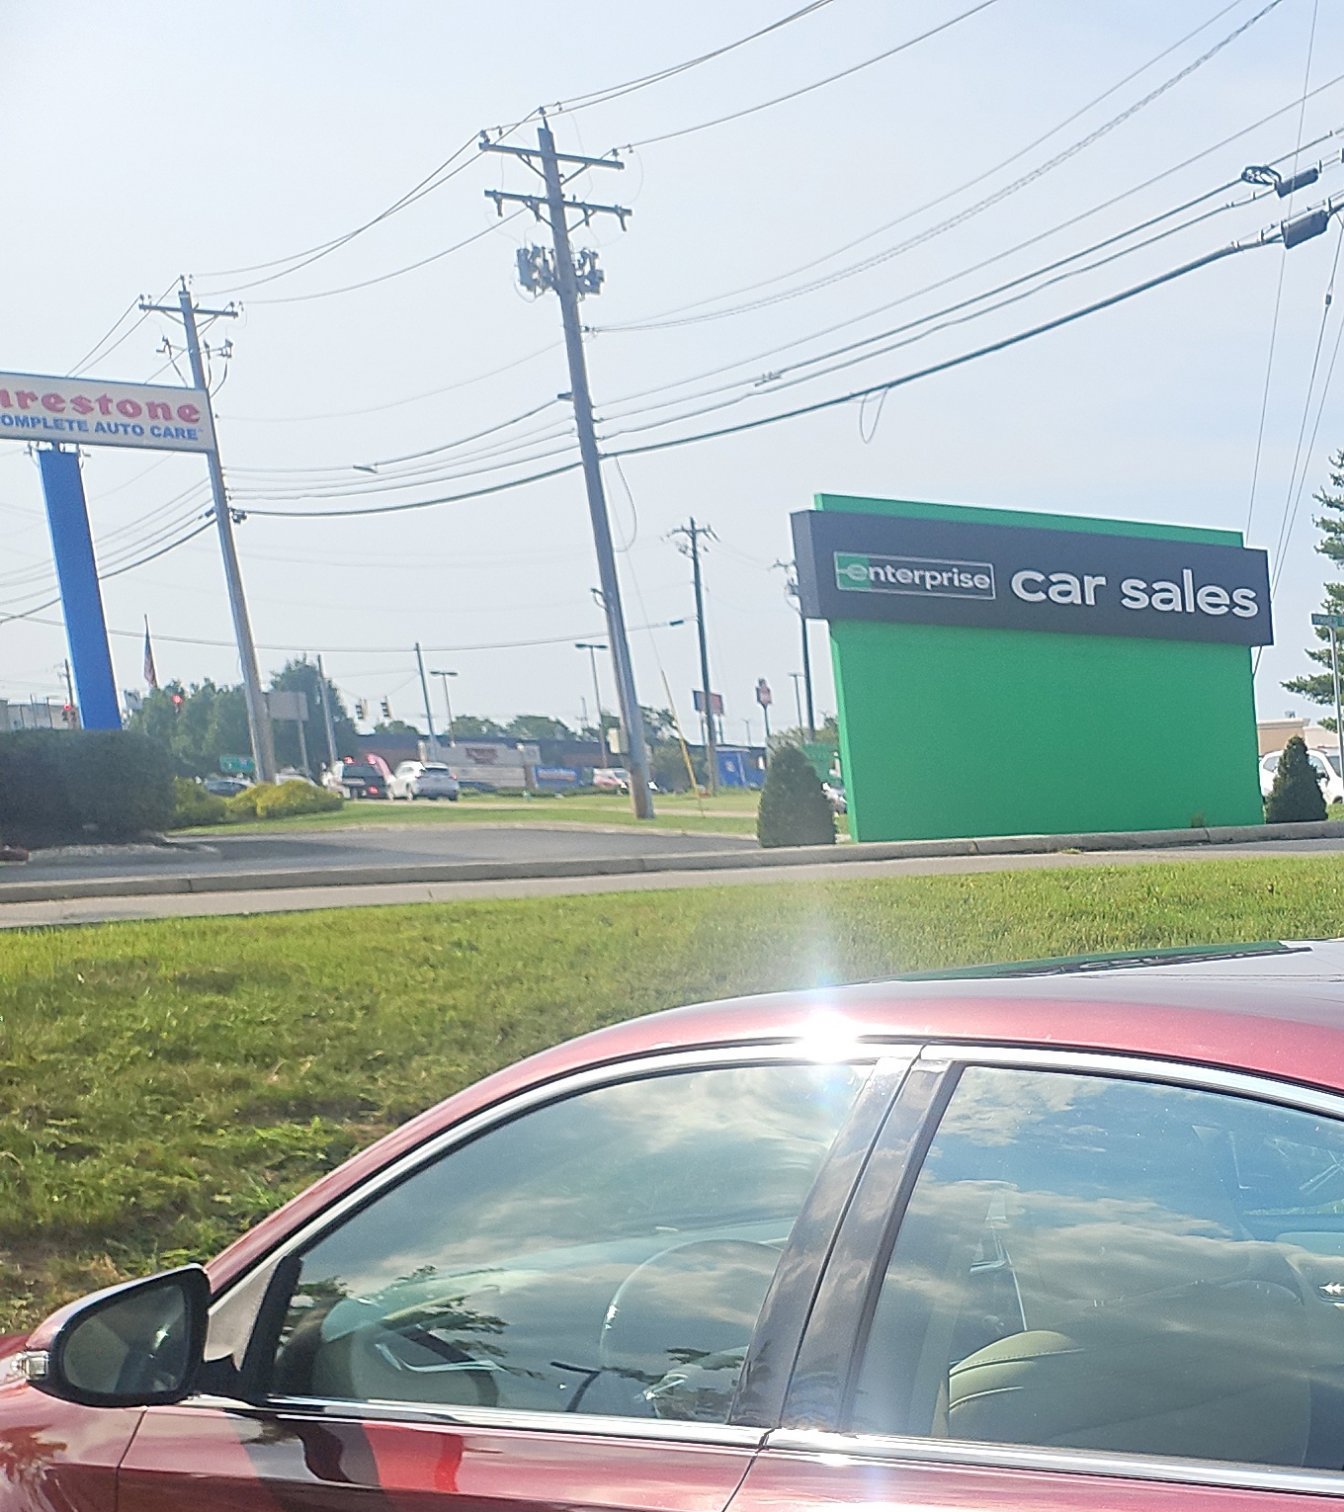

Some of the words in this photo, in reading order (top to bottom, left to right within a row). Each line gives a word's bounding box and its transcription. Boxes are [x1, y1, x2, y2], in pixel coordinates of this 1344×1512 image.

[0, 413, 89, 433] OMPLETE
[95, 421, 145, 437] AUTO
[150, 425, 198, 441] CARE
[846, 563, 991, 590] enterprise
[1010, 570, 1107, 606] car
[1120, 568, 1259, 618] sales
